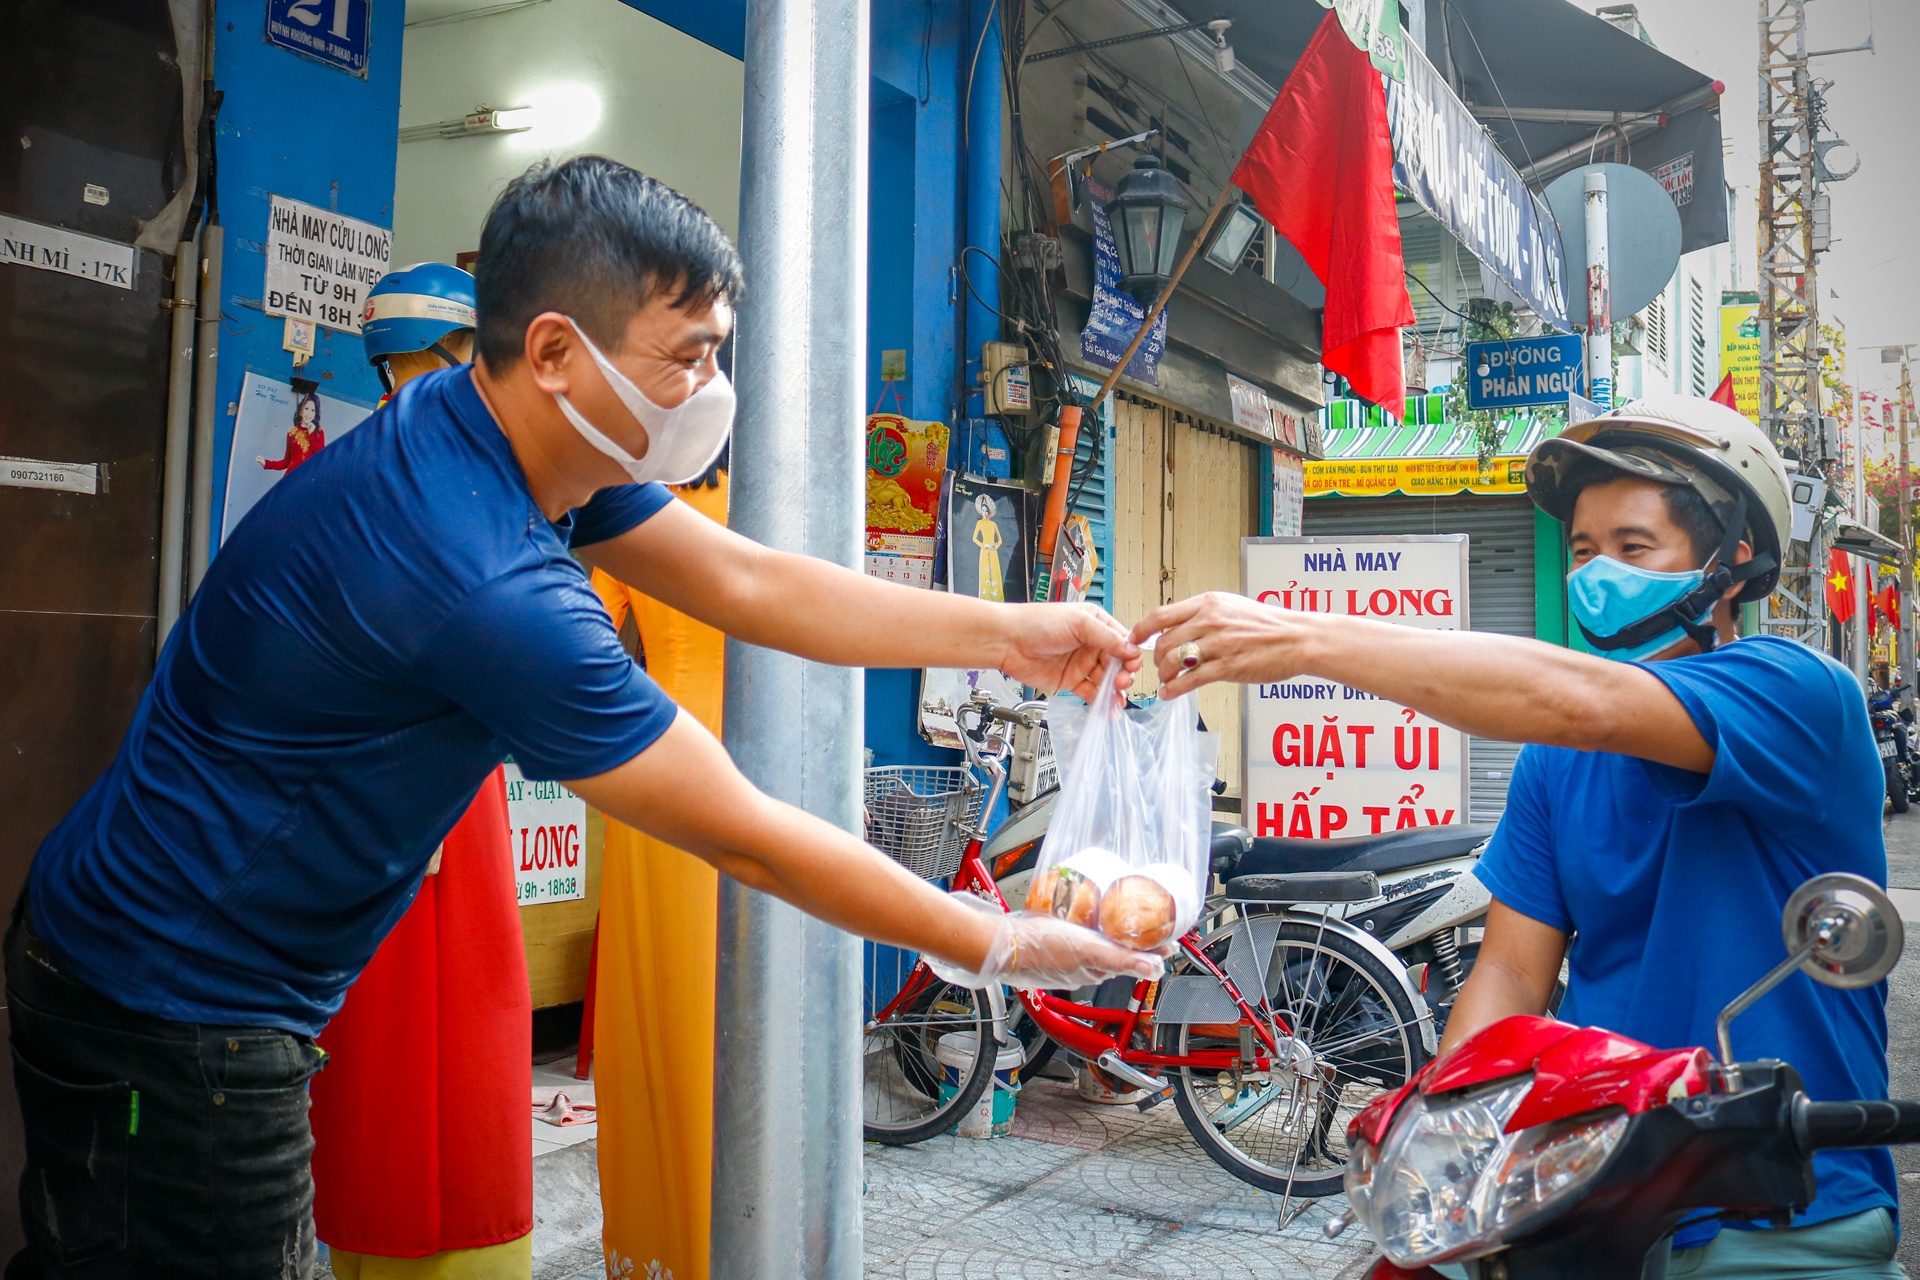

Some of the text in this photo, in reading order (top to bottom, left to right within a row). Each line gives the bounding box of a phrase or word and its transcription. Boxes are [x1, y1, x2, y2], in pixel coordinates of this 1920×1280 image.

[272, 205, 389, 263] NHÀ MAY CỬU LONG
[0, 238, 36, 262] NH
[42, 247, 70, 271] MÌ
[94, 261, 128, 285] 17K
[278, 242, 305, 266] THỜI
[307, 251, 333, 274] GIAN
[335, 257, 356, 282] LÀM
[300, 273, 356, 304] TỪ 9H
[268, 290, 312, 316] ĐẾN
[319, 303, 351, 326] 18H
[1490, 344, 1561, 367] ĐƯỜNG
[11, 469, 65, 482] 0907321160
[1338, 478, 1351, 487] TRE
[1365, 475, 1387, 488] QUẢNG
[1411, 478, 1425, 486] GIAO
[1426, 476, 1444, 486] HÀNG
[1445, 476, 1458, 487] TẬN
[1471, 477, 1487, 486] LIÊ
[1304, 548, 1402, 572] NHÀ MAY
[1346, 588, 1454, 616] LONG
[1259, 684, 1337, 700] LAUNDRY
[1272, 708, 1440, 780] GIẶT ỦI
[505, 781, 525, 802] AY
[1256, 786, 1348, 839] HẤP
[520, 823, 580, 871] LONG
[524, 882, 537, 899] 9h
